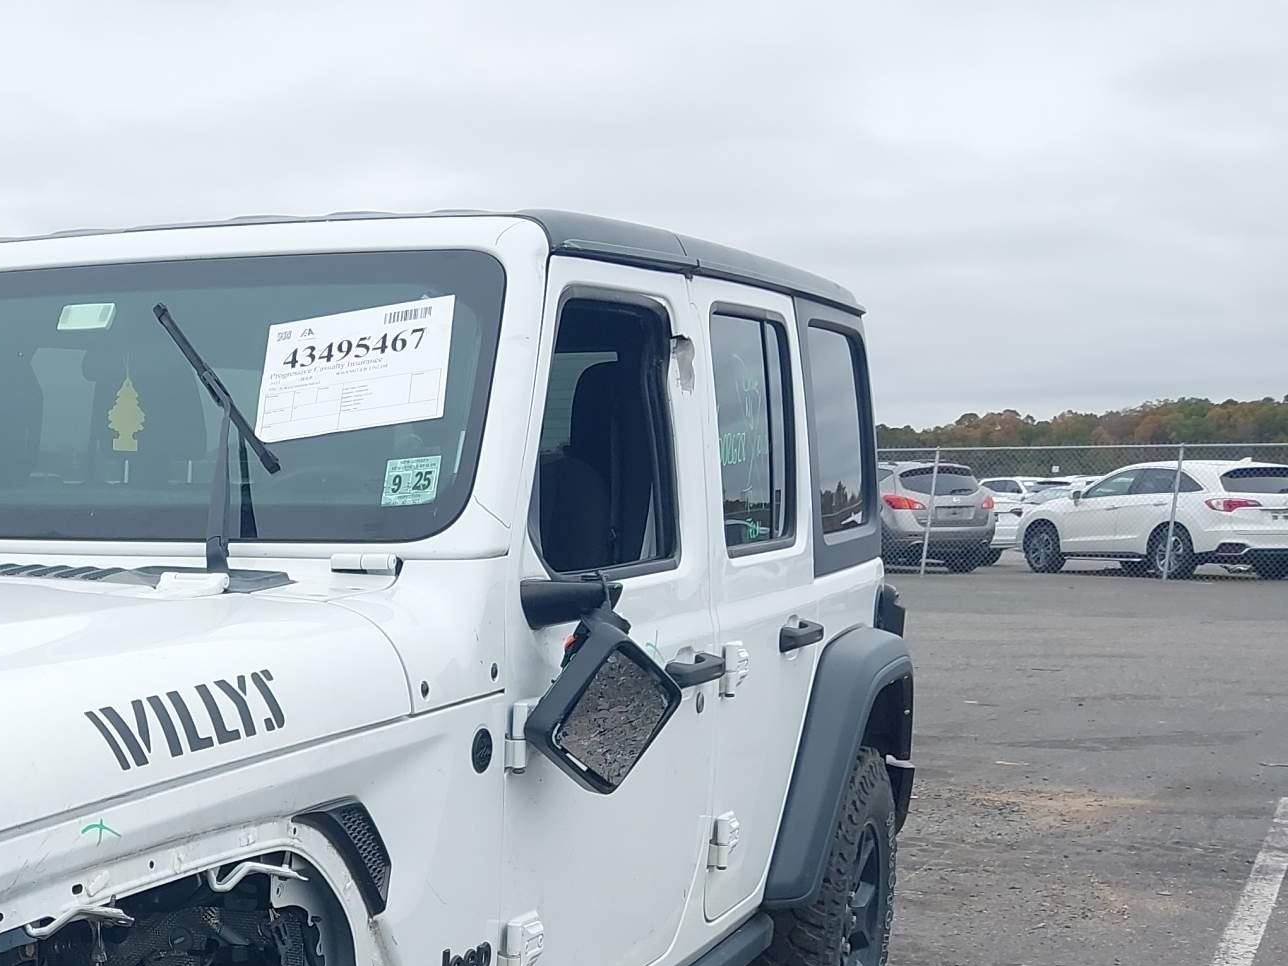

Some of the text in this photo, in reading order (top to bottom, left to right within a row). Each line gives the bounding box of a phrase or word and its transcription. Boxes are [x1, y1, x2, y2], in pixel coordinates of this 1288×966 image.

[283, 327, 427, 369] 43495467
[391, 470, 433, 493] 9 25
[84, 669, 285, 771] WILLYS
